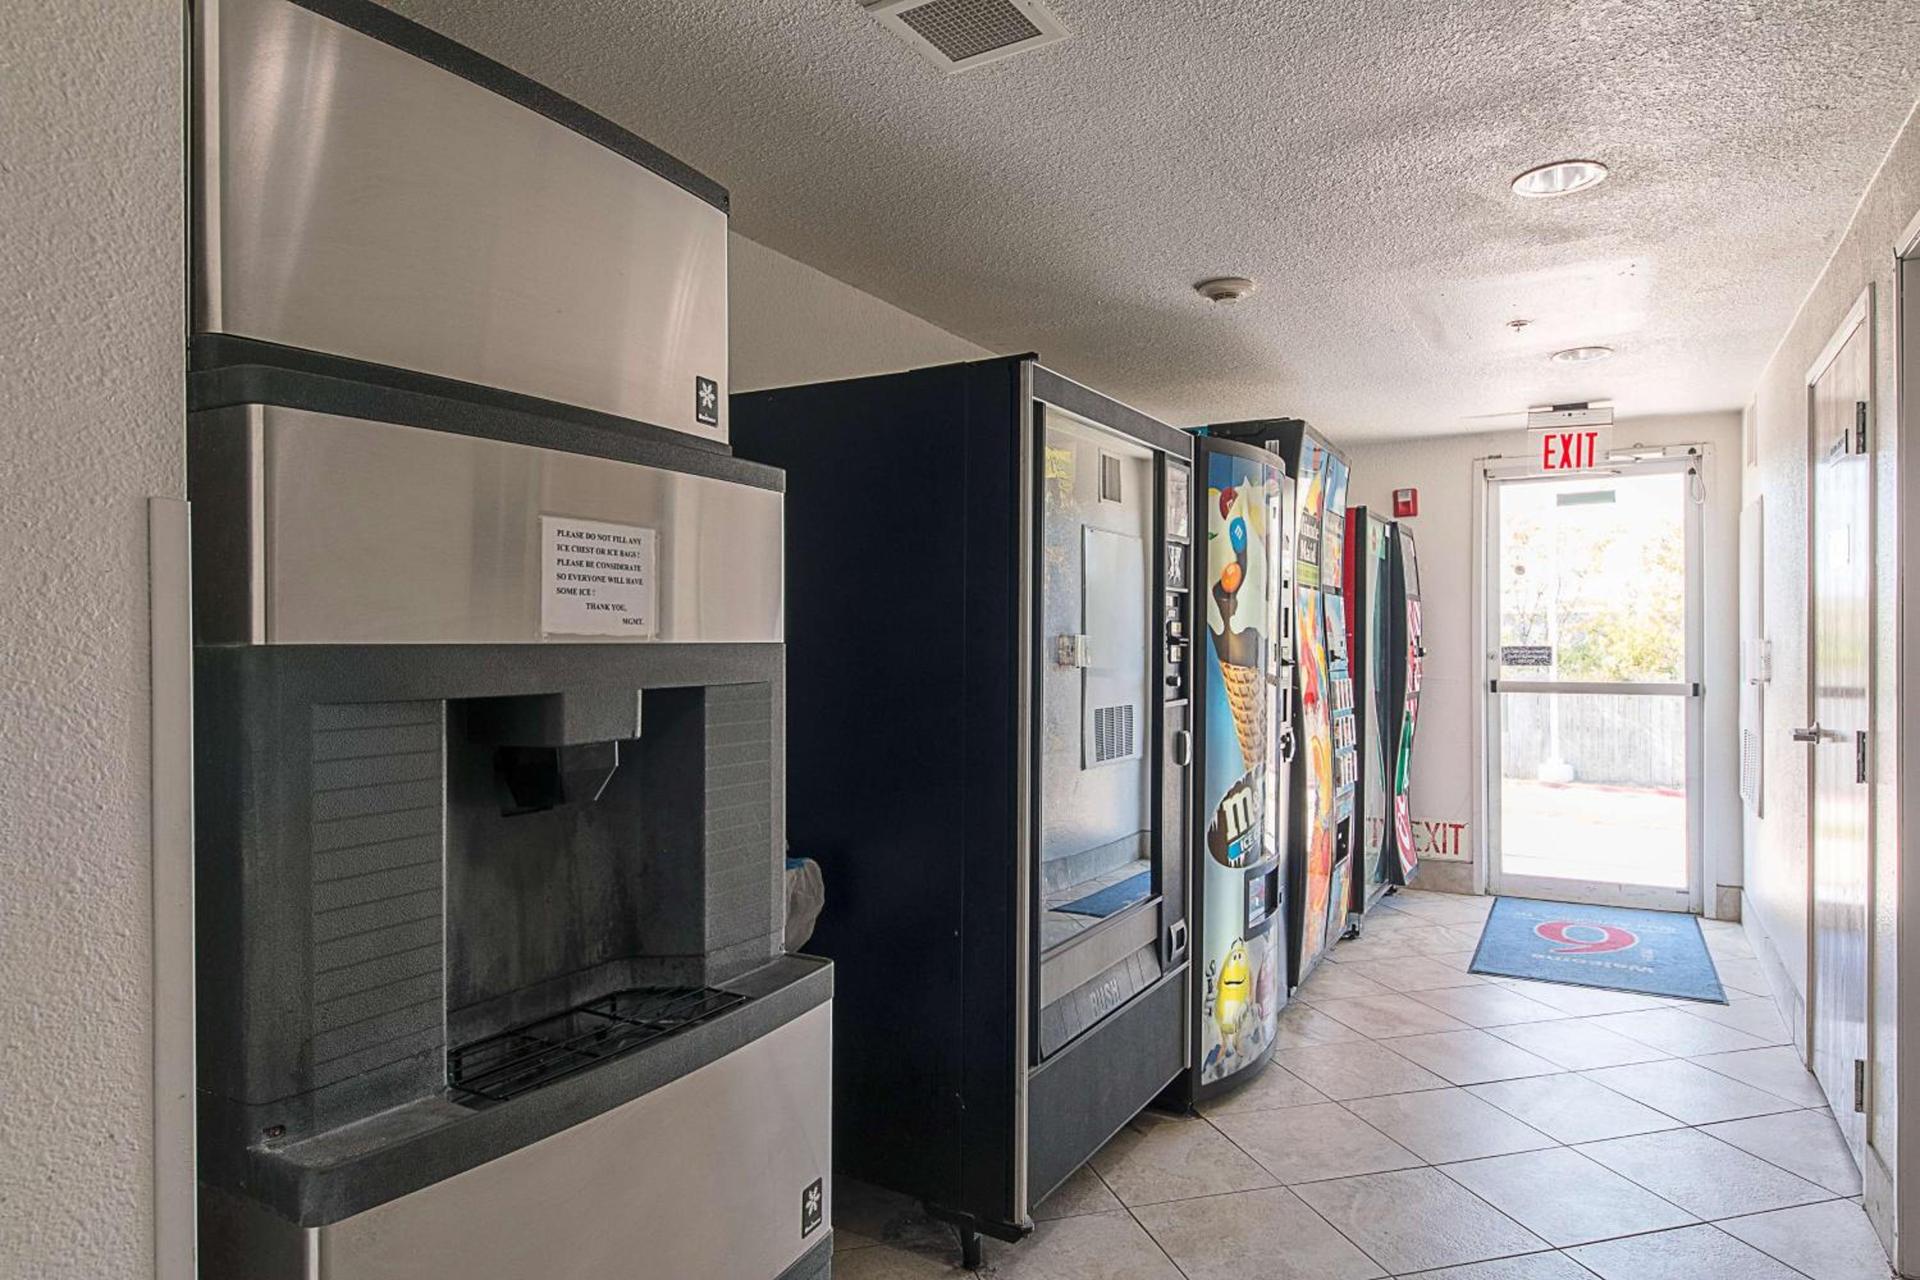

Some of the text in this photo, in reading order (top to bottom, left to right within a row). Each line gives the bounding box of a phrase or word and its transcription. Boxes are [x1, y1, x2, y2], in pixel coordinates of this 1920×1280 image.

[1543, 432, 1599, 470] EXIT
[556, 529, 642, 546] PLEASE DO NOT FILL ANY
[556, 543, 571, 552] ICE
[571, 545, 595, 554] CHEST
[595, 547, 606, 555] OR
[556, 558, 642, 572] PLEASE BE CONSIDERATE
[556, 572, 645, 586] SO EVERYONE WILL HAVE
[556, 586, 578, 596] SOME
[585, 602, 611, 611] THANK
[1410, 820, 1466, 856] EXIT
